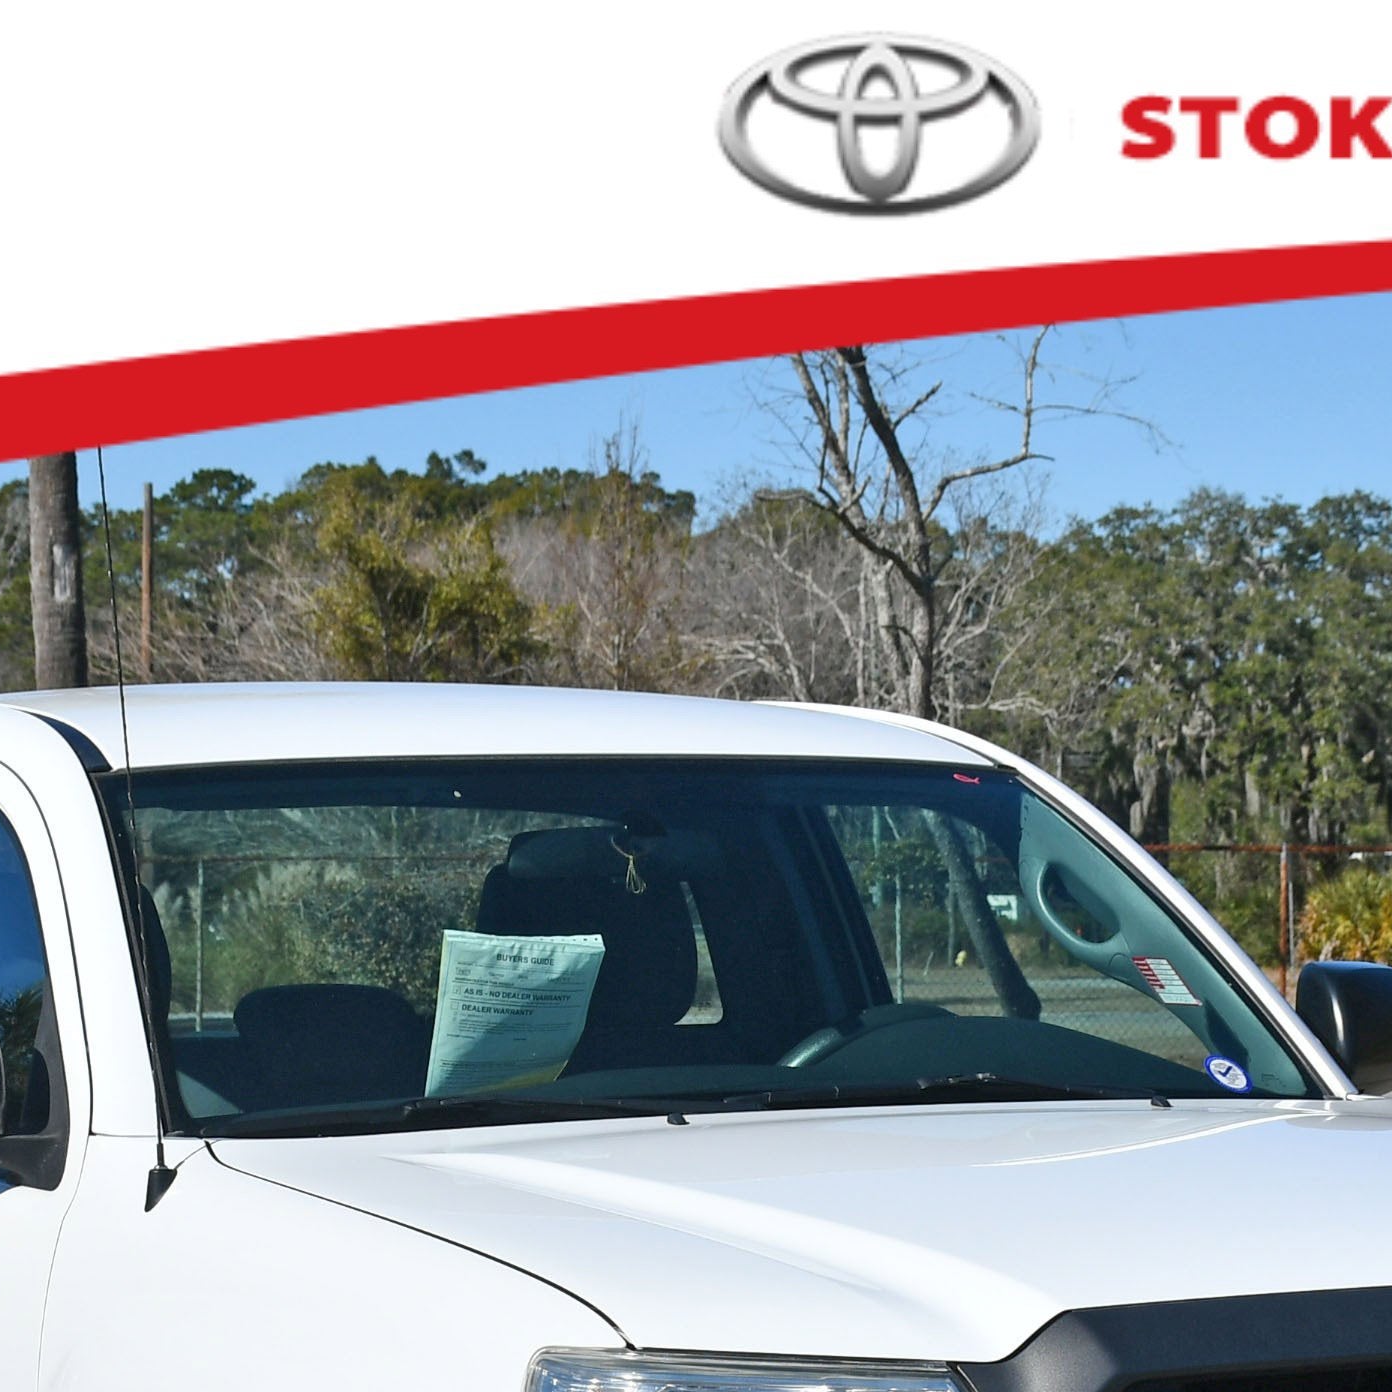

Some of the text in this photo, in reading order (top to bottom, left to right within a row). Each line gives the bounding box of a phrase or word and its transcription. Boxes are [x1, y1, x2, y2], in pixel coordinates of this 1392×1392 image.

[496, 953, 555, 967] BUYERS GUIDE
[502, 992, 531, 1000] DEALER
[462, 1004, 492, 1014] DEALER
[493, 1007, 534, 1016] WARRANTY
